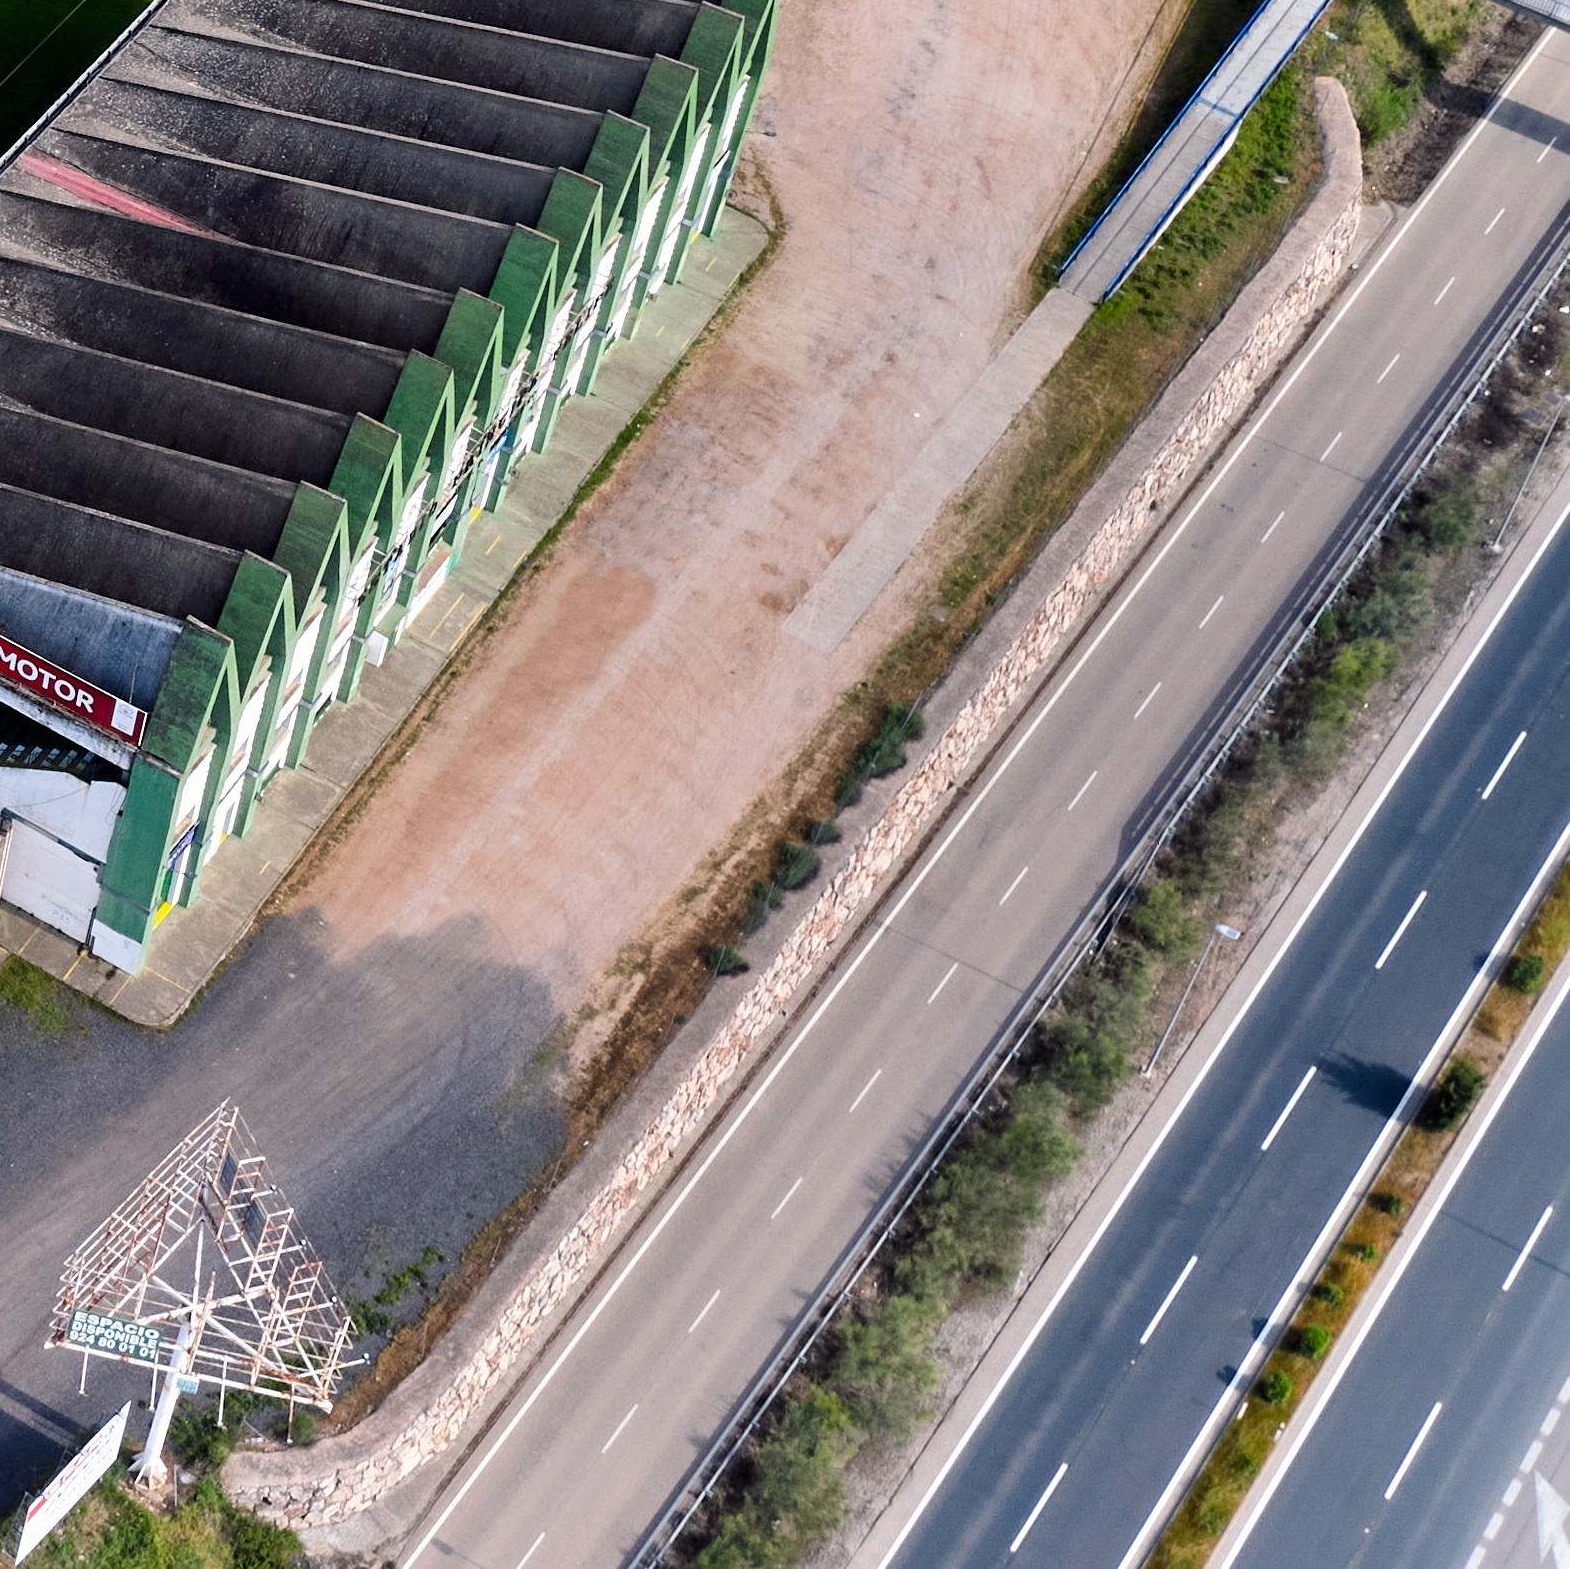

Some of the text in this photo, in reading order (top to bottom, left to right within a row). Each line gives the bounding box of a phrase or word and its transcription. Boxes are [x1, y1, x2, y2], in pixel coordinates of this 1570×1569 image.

[72, 1321, 157, 1350] DISPONIBLE
[74, 1311, 159, 1339] ESPACIO
[69, 1331, 156, 1359] 924 80 01 01
